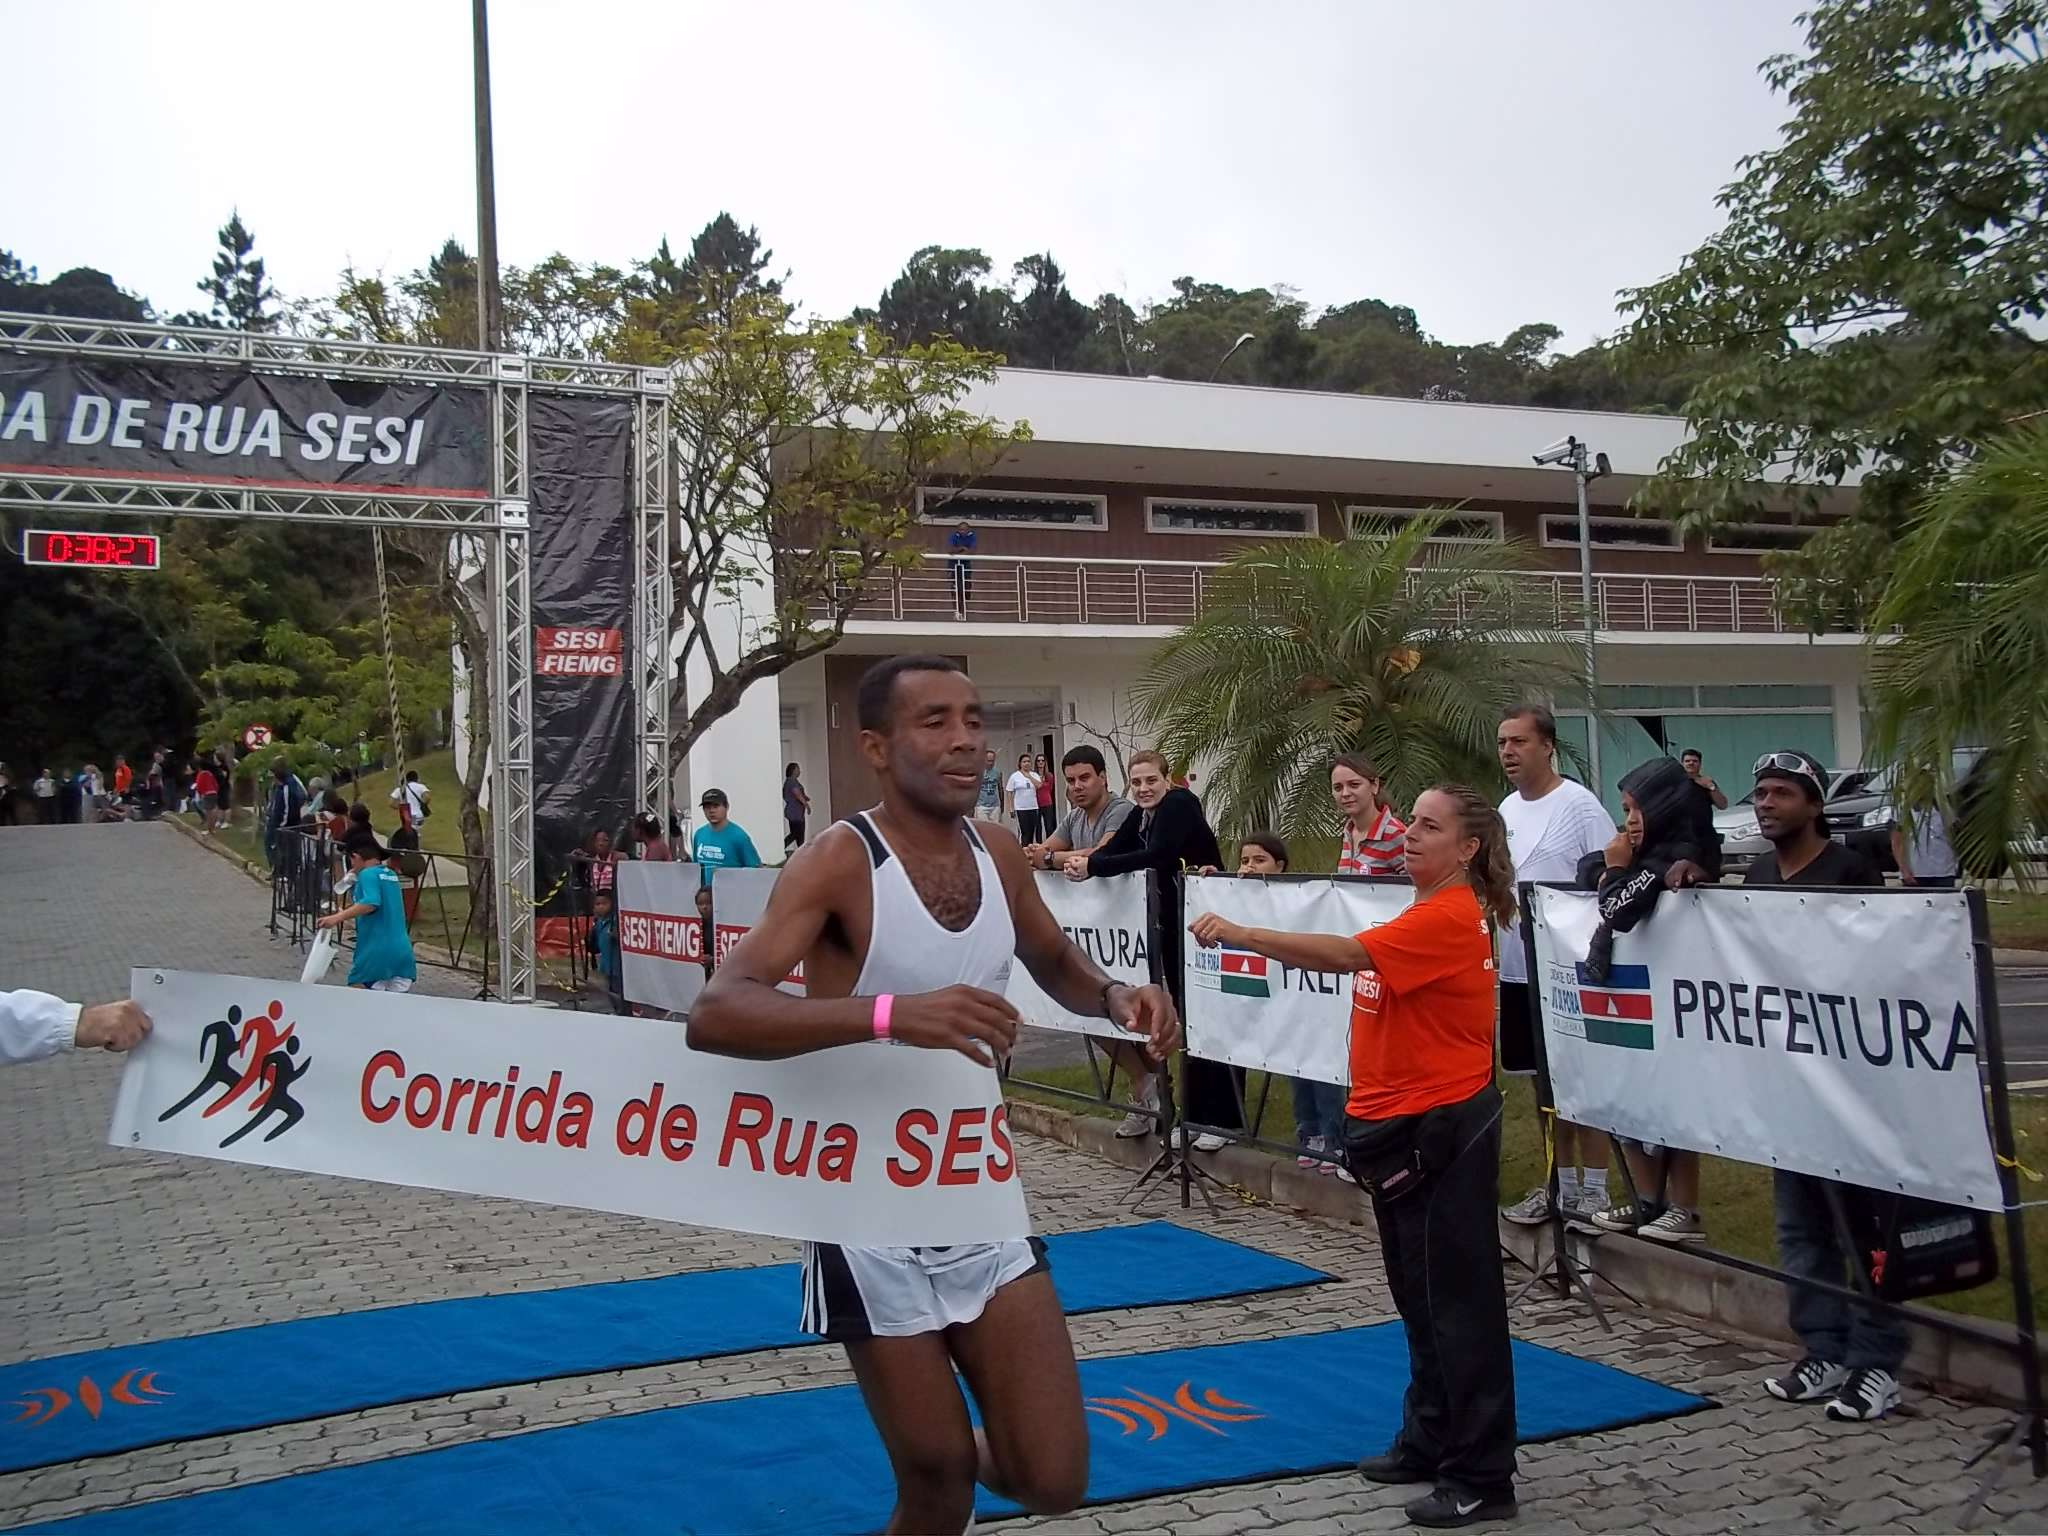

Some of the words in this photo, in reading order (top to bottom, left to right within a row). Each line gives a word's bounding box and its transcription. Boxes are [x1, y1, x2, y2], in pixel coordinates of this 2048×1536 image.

[0, 391, 47, 442] A
[67, 394, 151, 448] DE
[162, 402, 282, 458] RUA
[301, 412, 425, 465] SESI
[543, 654, 617, 673] FIEMG
[553, 631, 606, 649] SESI
[623, 915, 651, 950] SESI
[654, 919, 700, 958] FIEMG
[1672, 978, 1976, 1071] PREFEITURA
[361, 1050, 593, 1149] Corrida
[616, 1082, 698, 1162] de
[718, 1091, 858, 1183] Rua
[886, 1104, 1020, 1187] SES
